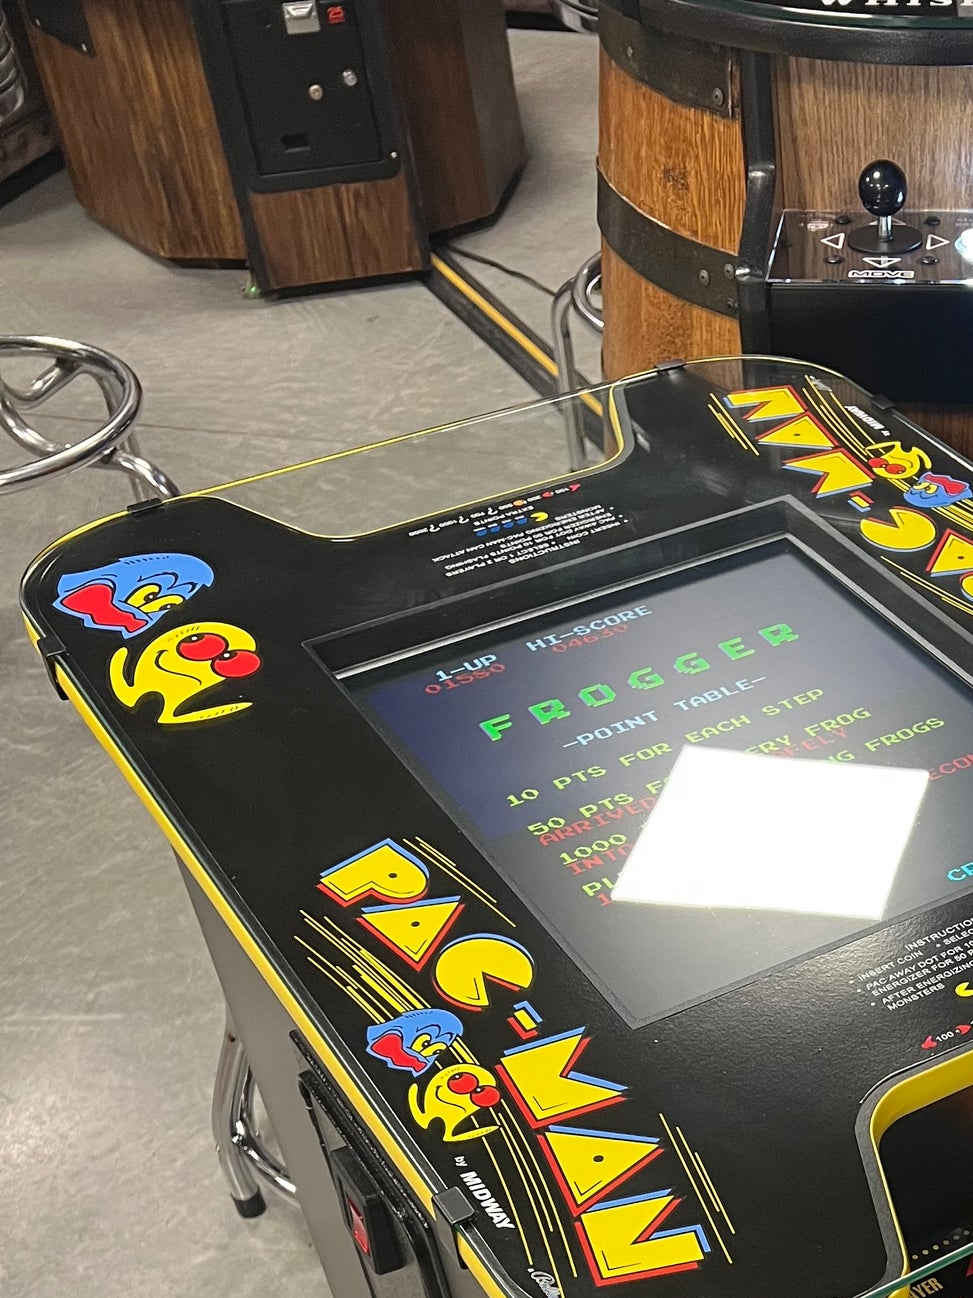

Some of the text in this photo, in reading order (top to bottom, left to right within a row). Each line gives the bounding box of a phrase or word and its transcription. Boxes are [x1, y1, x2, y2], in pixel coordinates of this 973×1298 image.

[848, 270, 914, 278] MOVE
[525, 605, 652, 652] HI-SCORE
[436, 654, 498, 682] 1-UP
[478, 622, 800, 742] FROGGER
[507, 688, 824, 807] 10 PTS FOR EACH STEP
[527, 816, 566, 836] 50
[579, 793, 634, 818] PTS
[804, 707, 872, 738] FROG
[559, 717, 945, 866] 1000 FROGS
[538, 796, 658, 847] ARRIVED
[858, 961, 895, 981] INSERT
[897, 950, 923, 964] COIN
[866, 977, 888, 990] PAC
[889, 964, 916, 981] AWAY
[918, 955, 939, 968] DOT
[940, 945, 964, 959] FOR
[871, 968, 931, 997] ENERGIZER
[931, 958, 955, 971] FOR
[882, 986, 917, 1005] AFTER
[887, 982, 945, 1011] MONSTERS
[936, 1030, 954, 1042] 100
[316, 838, 711, 1287] PAC-MAN
[454, 1156, 515, 1229] by MIDWAY
